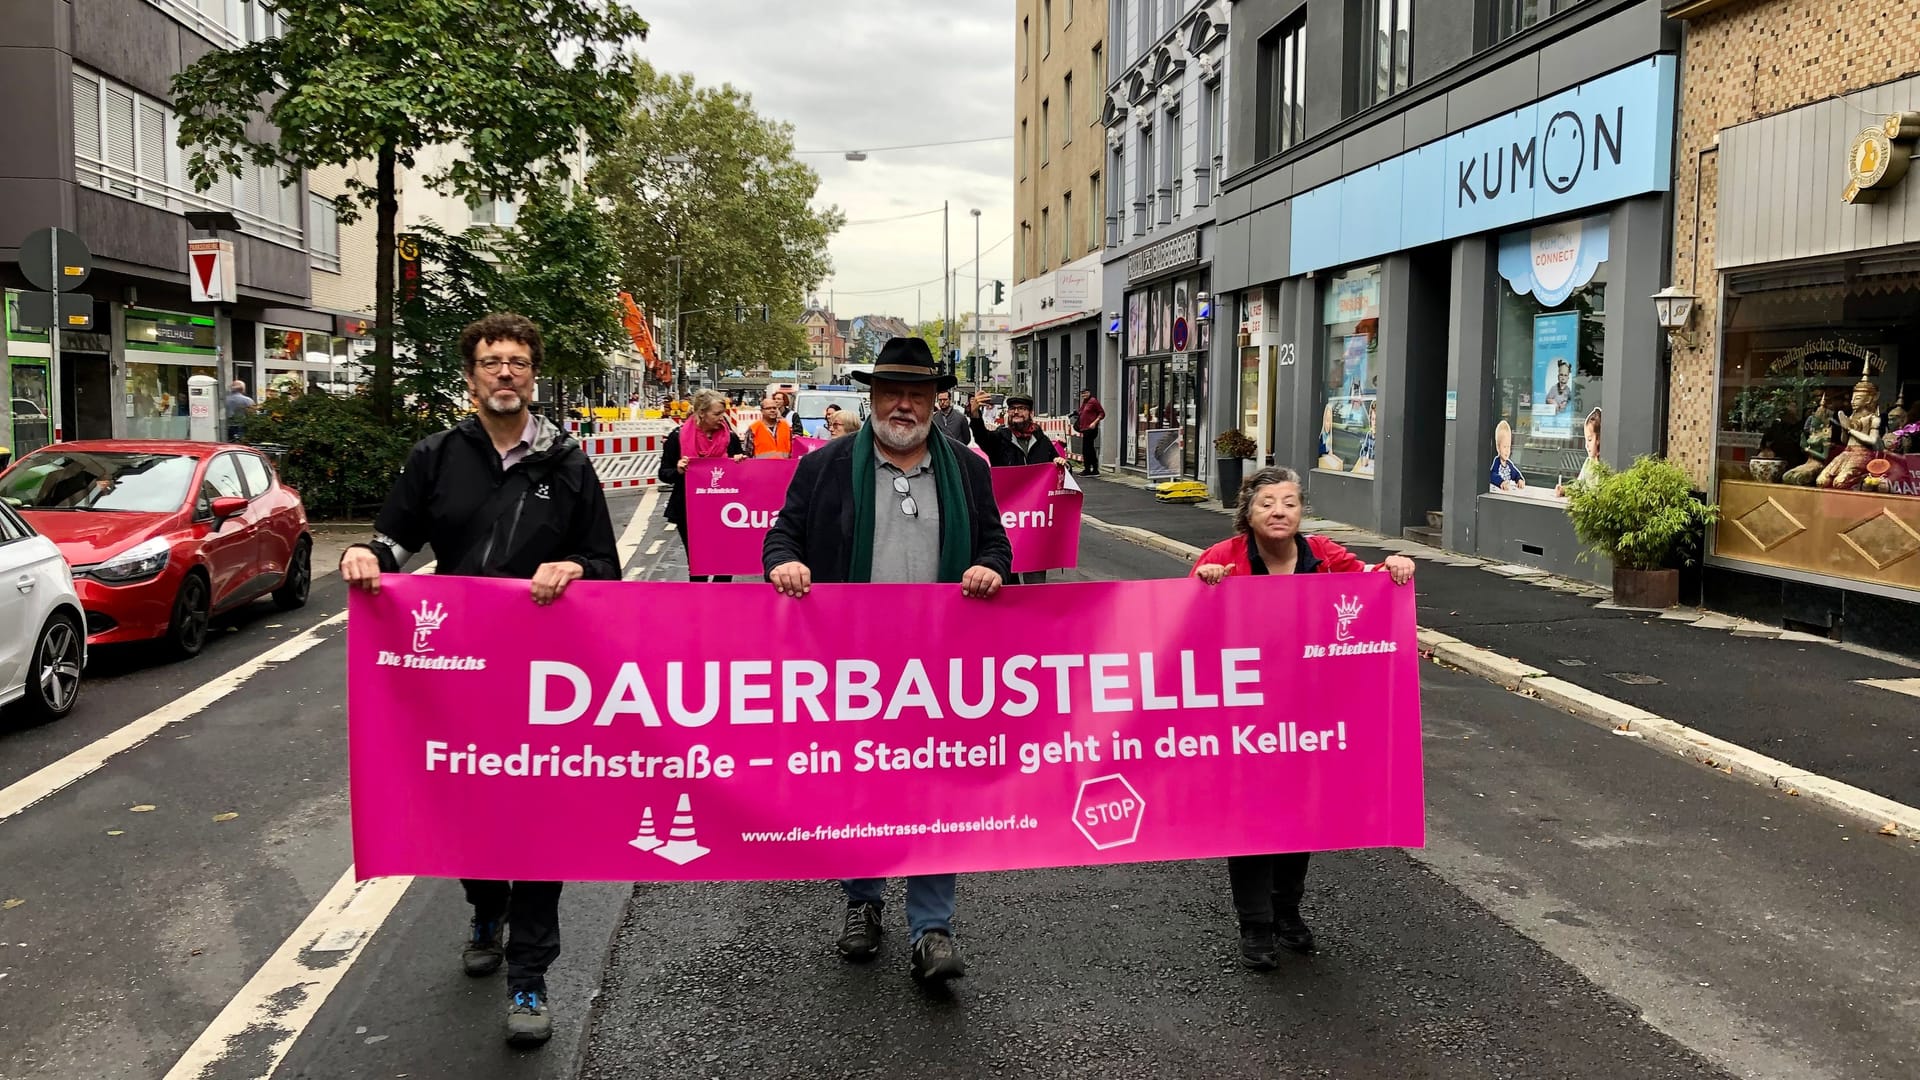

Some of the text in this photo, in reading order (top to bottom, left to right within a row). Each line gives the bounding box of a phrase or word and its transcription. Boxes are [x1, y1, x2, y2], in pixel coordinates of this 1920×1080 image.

[1459, 106, 1623, 208] KUMON
[1535, 249, 1575, 266] CONNECT
[157, 328, 194, 340] SPIELHALLE
[1280, 343, 1295, 366] 23
[376, 651, 486, 670] Die Friedrichs
[1303, 640, 1397, 659] Die Friedrichs
[528, 647, 1265, 728] DAUERBAUSTELLE
[426, 740, 735, 779] Friedrichstraße
[787, 742, 841, 775] ein
[854, 734, 1006, 772] Stadtteil
[1019, 731, 1101, 774] geht
[1112, 730, 1142, 760] in
[1154, 726, 1219, 758] den
[1232, 721, 1347, 755] Keller!
[1085, 798, 1136, 826] STOP
[741, 814, 1038, 842] www.die-friedrichstrasse-duesseldorf.de
